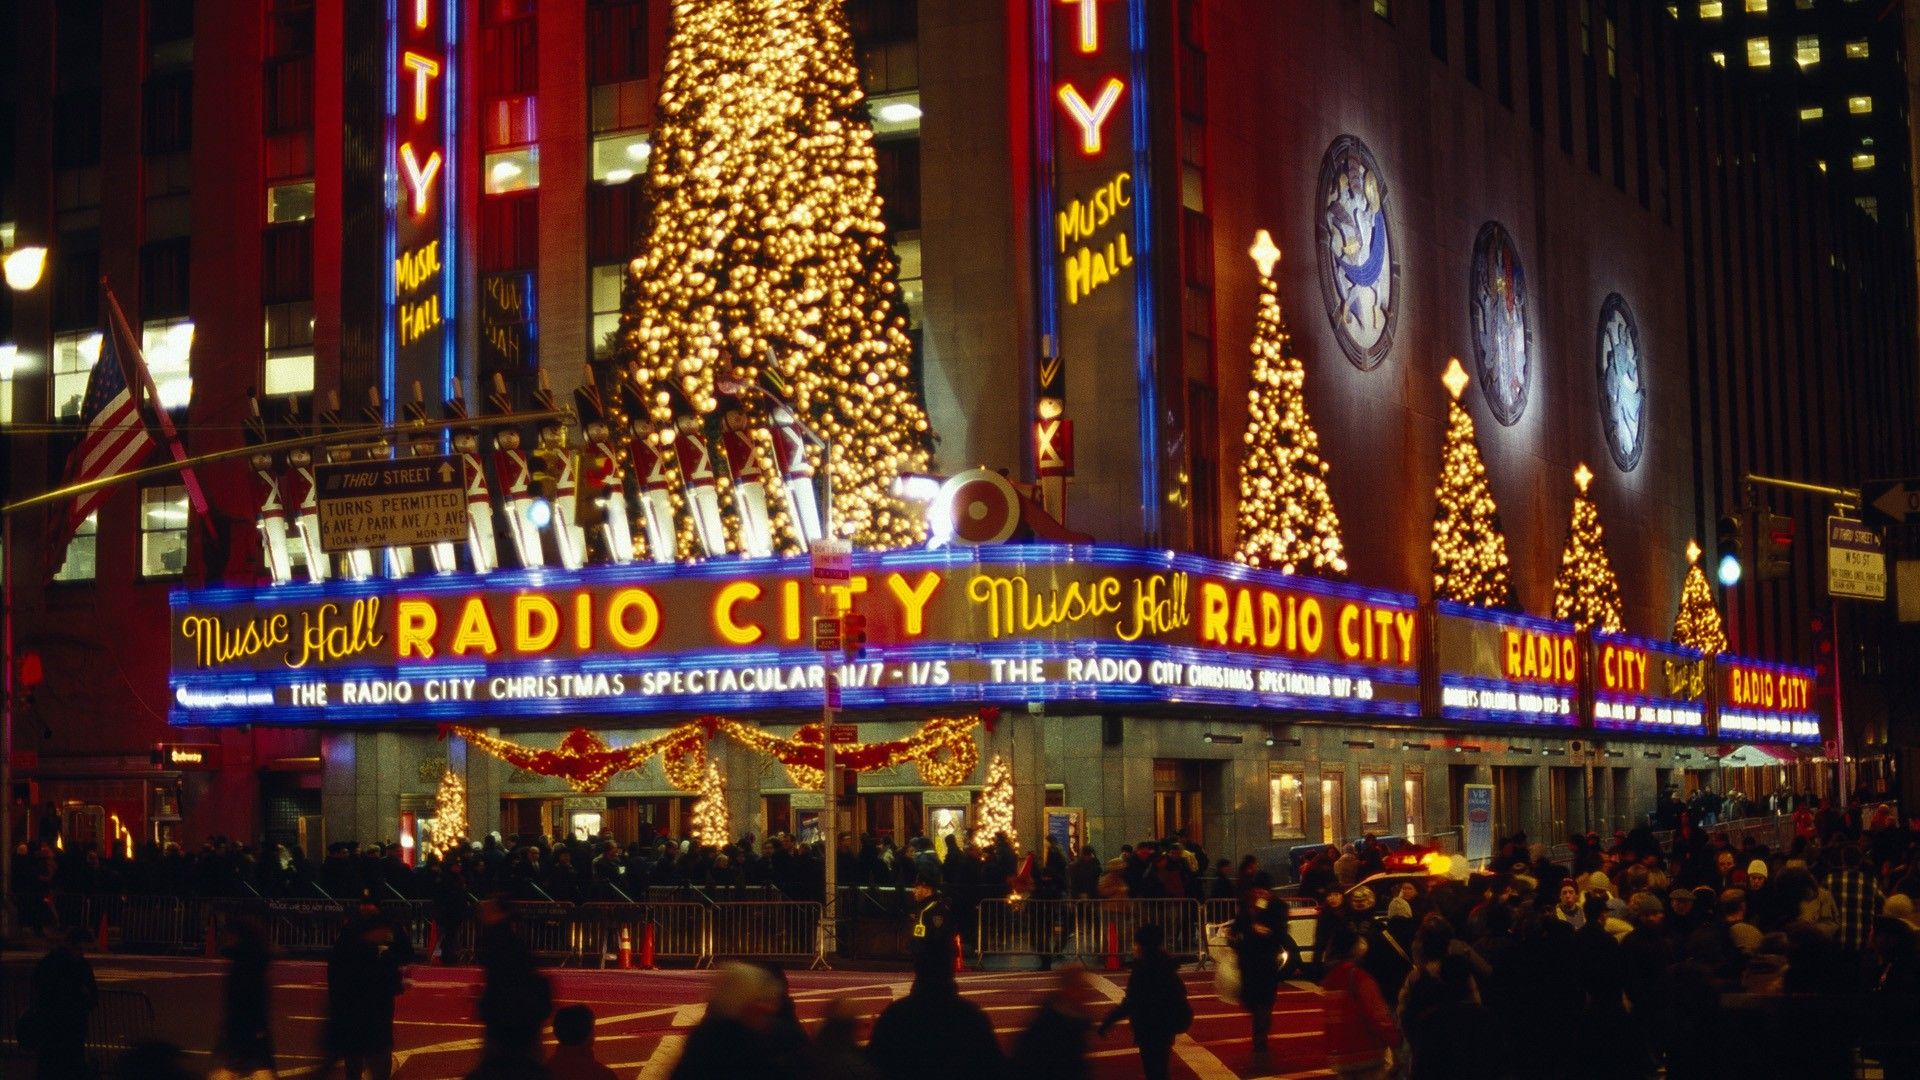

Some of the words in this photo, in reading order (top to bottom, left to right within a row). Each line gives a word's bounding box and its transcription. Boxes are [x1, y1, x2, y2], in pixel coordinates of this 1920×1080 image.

[1059, 172, 1131, 253] MUSIC
[395, 240, 441, 294] MUSIC
[1065, 233, 1133, 305] HALL
[401, 295, 441, 346] HALL
[342, 471, 379, 488] THRU
[383, 467, 432, 484] STREET
[323, 521, 330, 534] 6
[333, 519, 355, 533] AVE
[367, 516, 397, 530] PARK
[401, 514, 420, 529] AVE
[434, 512, 440, 525] 3
[445, 510, 466, 525] AVE
[327, 501, 373, 517] TURNS
[382, 494, 458, 512] PERMITTED
[182, 613, 289, 667] Music
[284, 596, 384, 669] Hall
[398, 588, 660, 659] RADIO
[969, 575, 1121, 638] Music
[1116, 571, 1190, 641] Hall
[1203, 582, 1323, 653] RADIO
[1338, 604, 1414, 662] CITY
[290, 682, 328, 705] THE
[342, 680, 413, 704] RADIO
[424, 678, 476, 702] CITY
[490, 673, 625, 699] CHRISTMAS
[642, 664, 825, 696] SPECTACULAR
[911, 661, 950, 686] 1/5
[990, 658, 1046, 683] THE
[1067, 658, 1143, 684] RADIO
[1150, 659, 1183, 685] CITY
[1188, 664, 1254, 691] CHRISTMAS
[1259, 669, 1331, 697] SPECTACULAR
[1507, 631, 1576, 681] RADIO
[1603, 646, 1647, 690] CITY
[1733, 669, 1774, 708] RADIO
[1779, 675, 1808, 709] CITY
